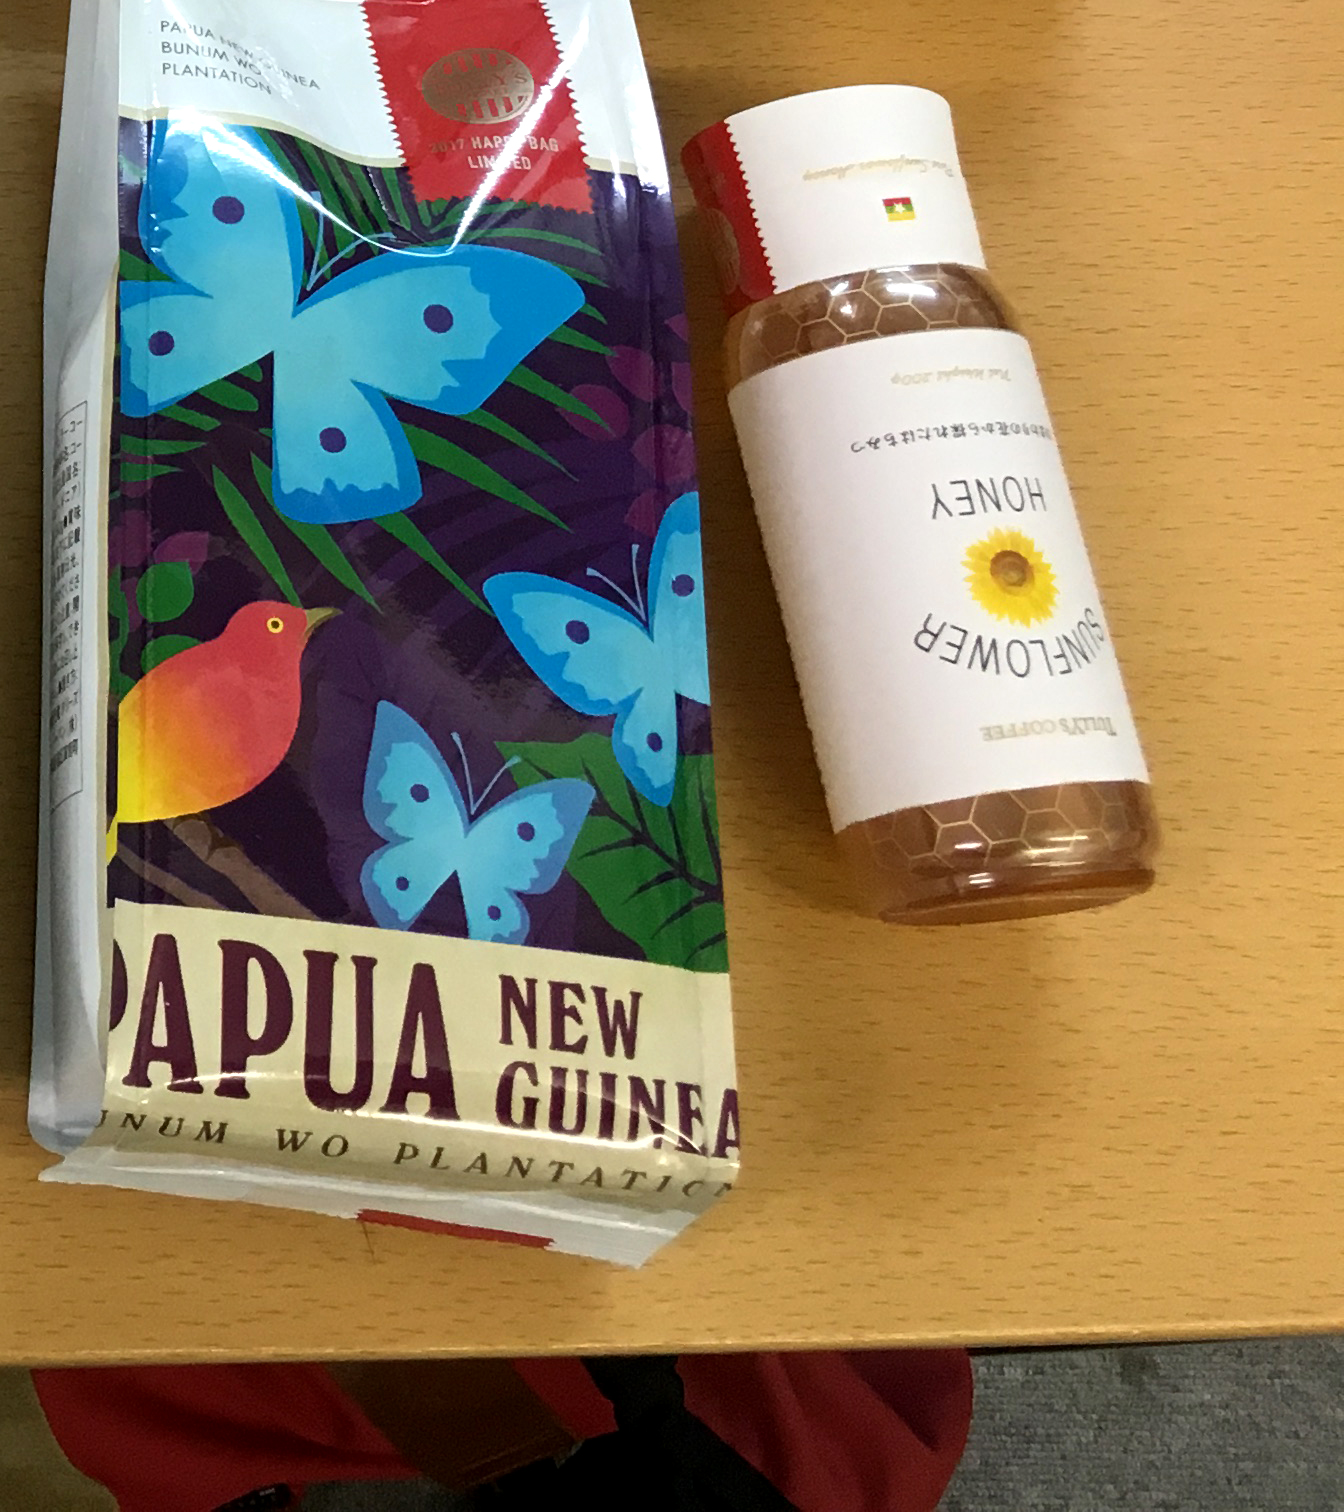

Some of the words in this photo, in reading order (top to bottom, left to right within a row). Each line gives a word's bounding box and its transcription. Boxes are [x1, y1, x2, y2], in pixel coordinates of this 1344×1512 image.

[162, 42, 229, 62] BUNUM
[234, 56, 261, 75] WO
[163, 63, 272, 94] PLANTATION
[527, 136, 559, 152] BAG
[468, 156, 531, 170] LIMED
[931, 476, 1047, 520] HONEY
[913, 608, 1104, 678] SUNFLOWER
[979, 720, 1056, 742] COFFEE
[498, 973, 644, 1061] NEW
[494, 1061, 740, 1159] GUINEA
[274, 1127, 351, 1161] WO
